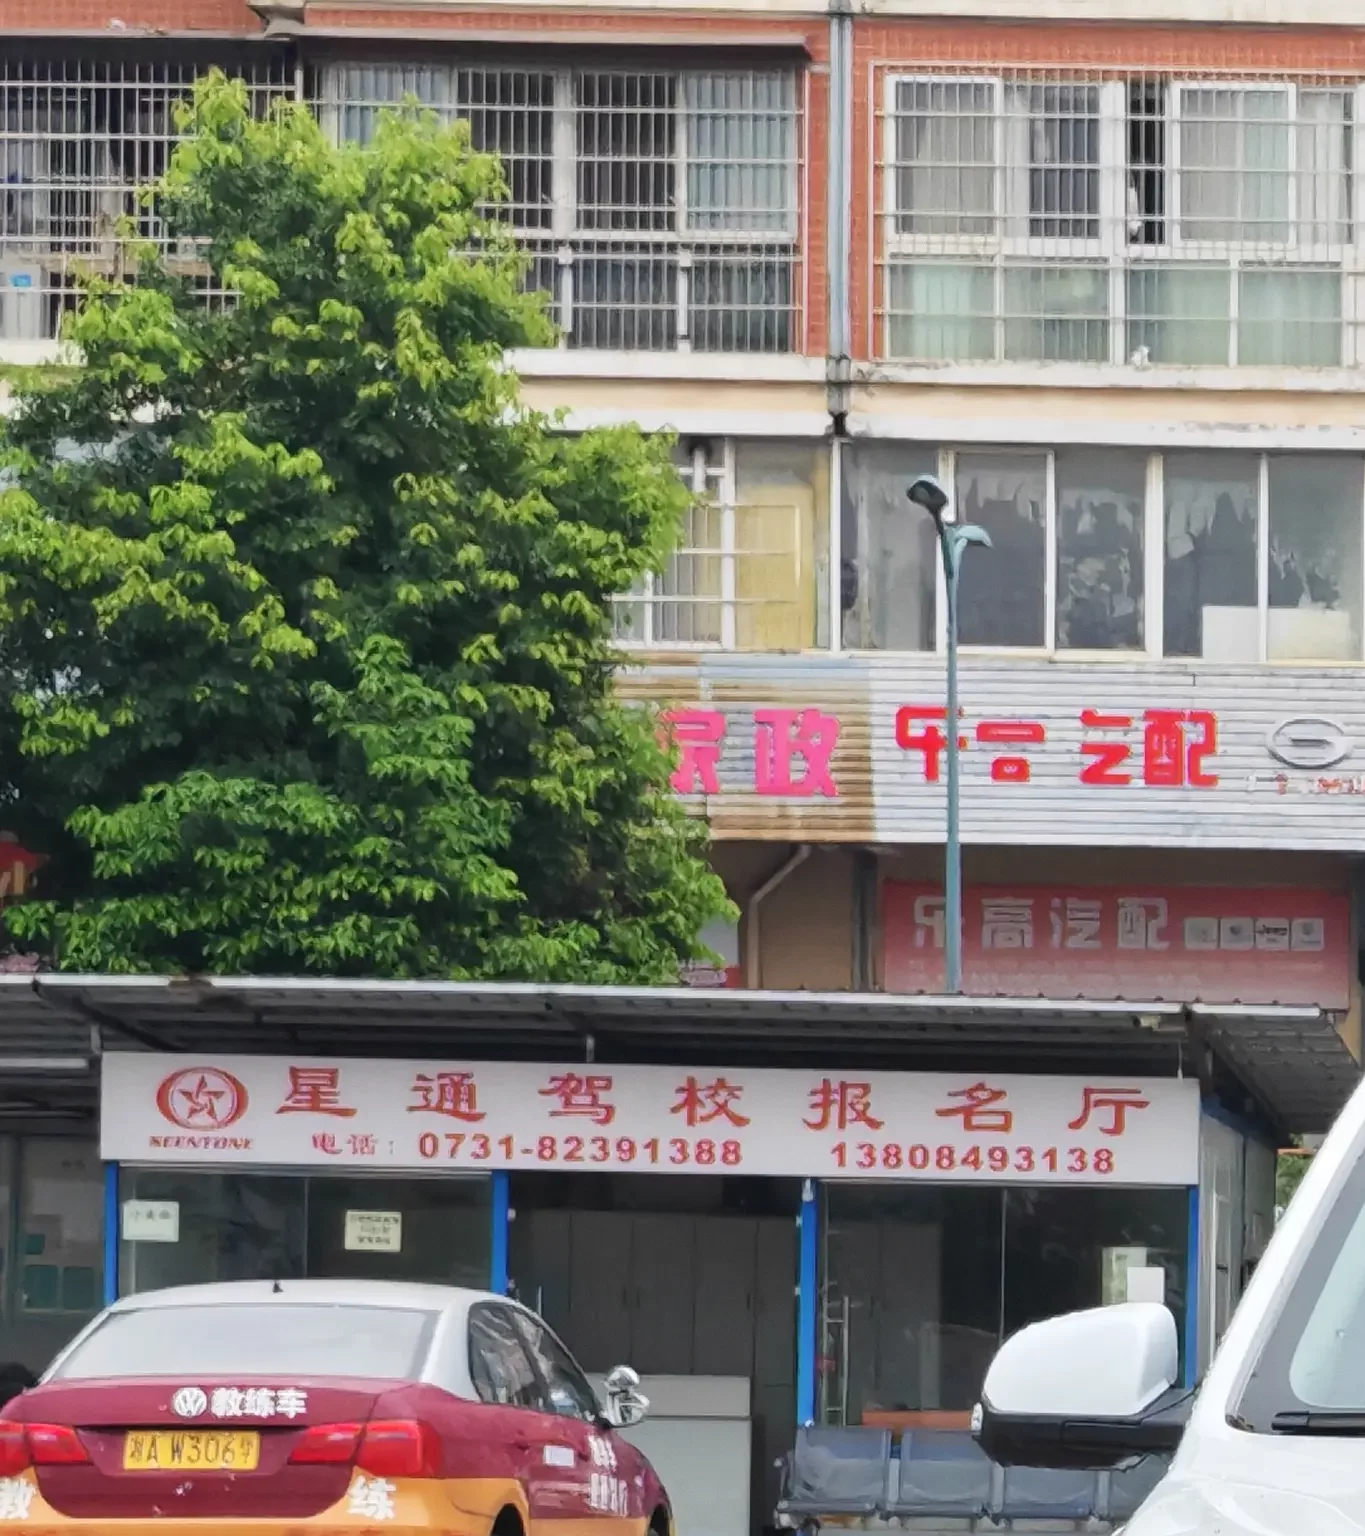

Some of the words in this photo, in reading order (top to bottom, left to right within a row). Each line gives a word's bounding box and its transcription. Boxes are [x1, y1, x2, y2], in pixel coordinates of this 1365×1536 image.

[914, 896, 1171, 950] 乐高汽配
[275, 1065, 1151, 1137] 星通驾校报名厅
[418, 1131, 744, 1166] 0731-82391388
[831, 1141, 1116, 1175] 13808493138
[210, 1387, 308, 1418] 教练车
[348, 1475, 398, 1521] 练
